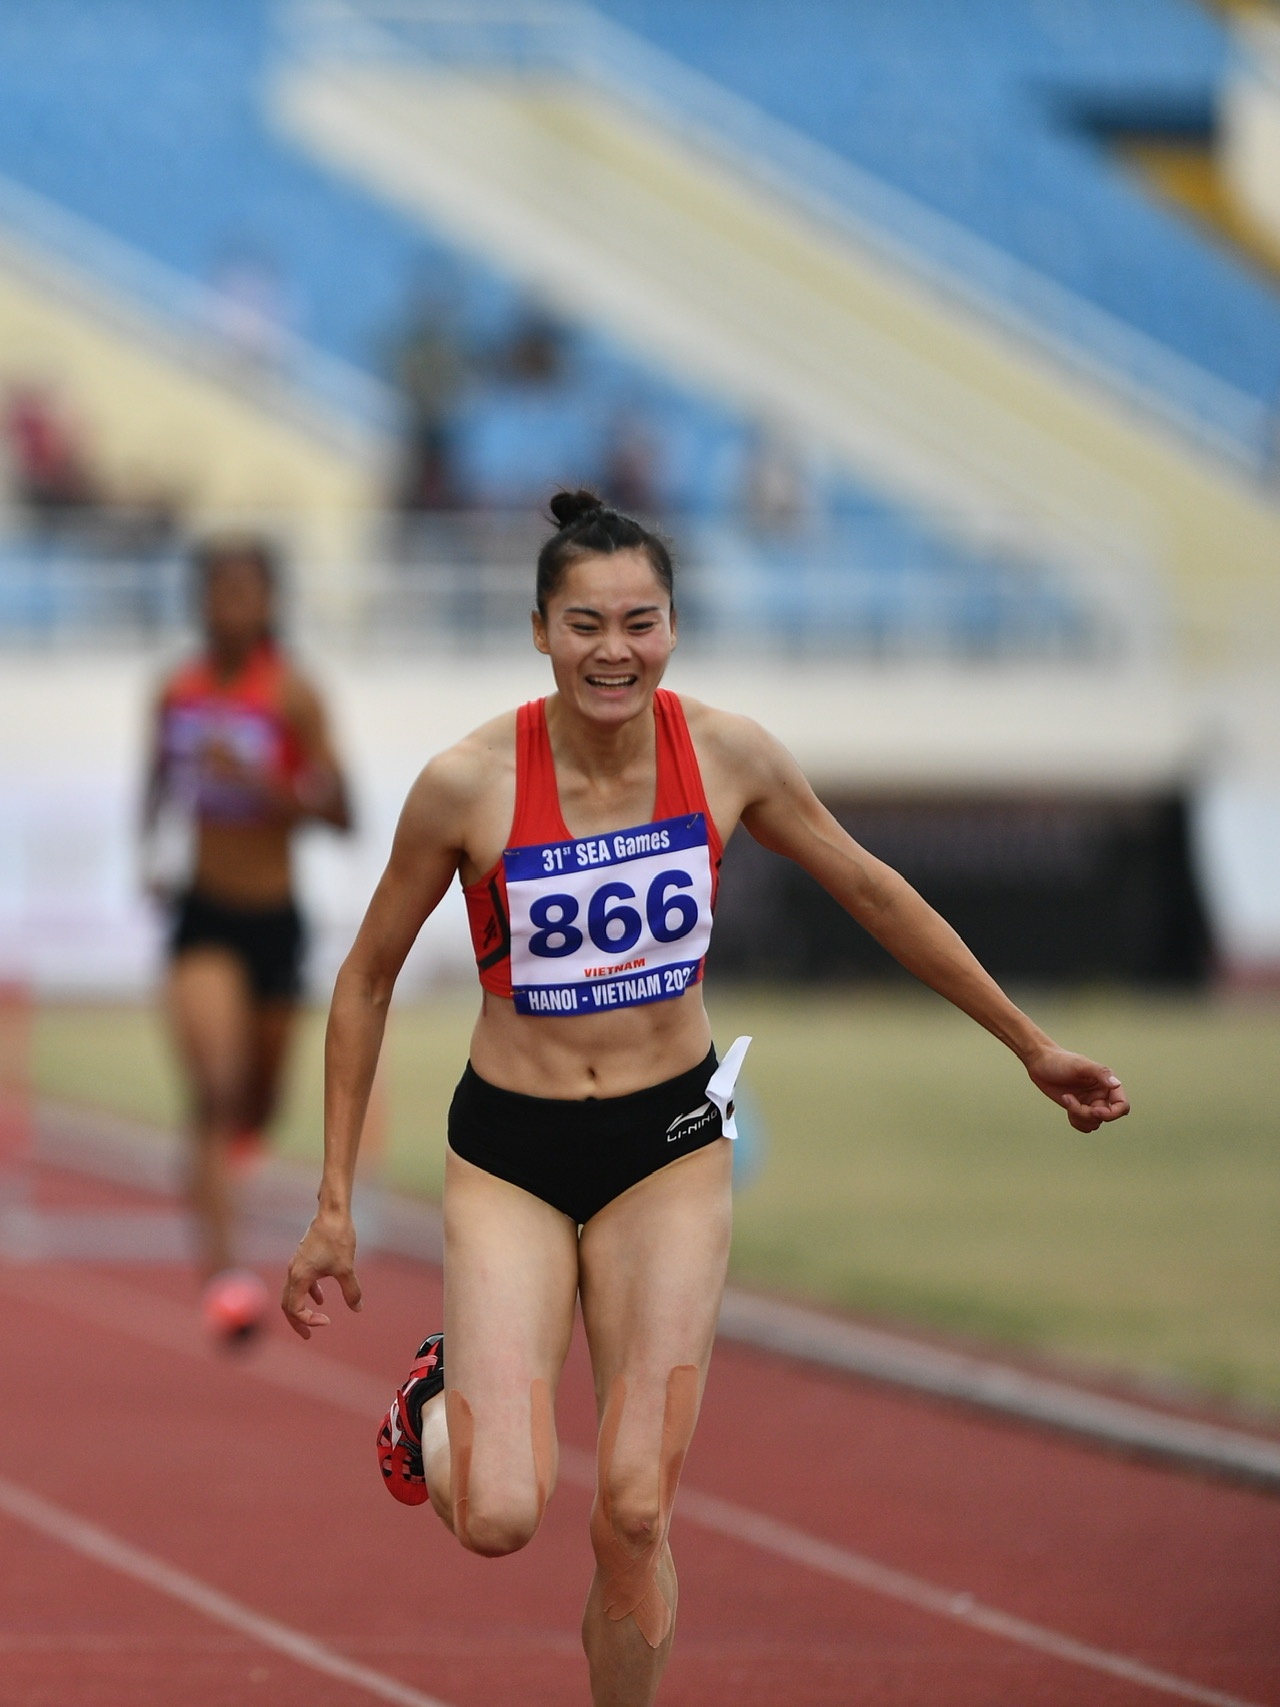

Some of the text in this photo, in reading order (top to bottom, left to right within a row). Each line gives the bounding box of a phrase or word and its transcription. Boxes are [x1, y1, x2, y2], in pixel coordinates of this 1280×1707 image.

[576, 842, 611, 867] SEA
[614, 830, 670, 858] Games
[528, 869, 699, 958] 866
[528, 988, 578, 1011] HANOI
[592, 974, 662, 1007] VIETNAM
[664, 966, 695, 992] 202
[584, 958, 646, 978] VIETNAM
